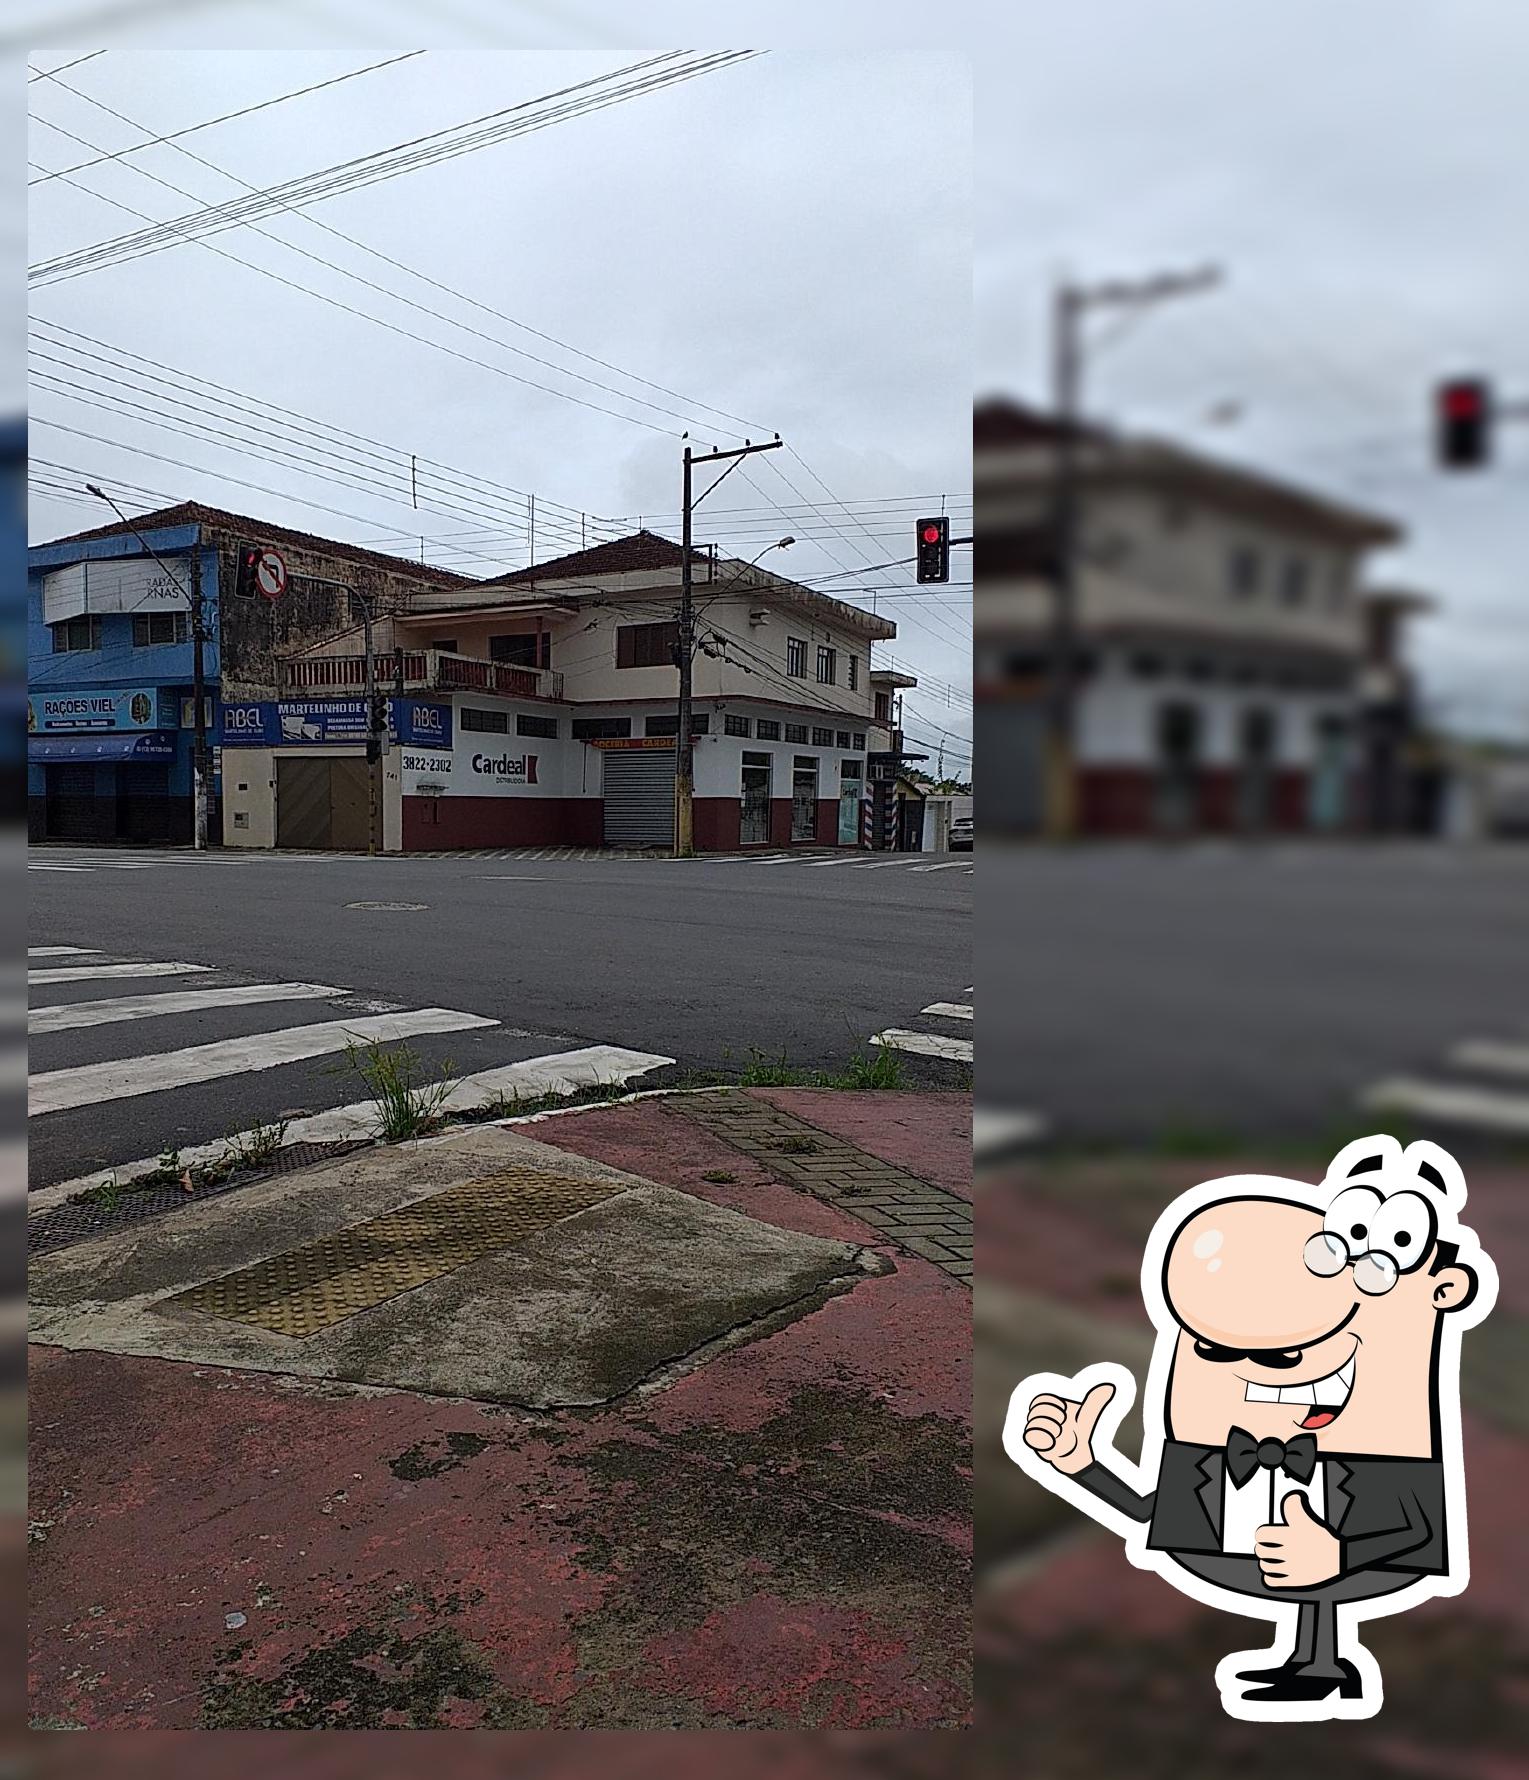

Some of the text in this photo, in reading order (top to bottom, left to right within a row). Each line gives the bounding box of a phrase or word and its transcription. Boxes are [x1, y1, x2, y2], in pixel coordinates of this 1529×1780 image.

[45, 697, 115, 717] RAÇÕES VIEL
[278, 703, 346, 715] MARTELINHO
[349, 703, 361, 712] DE
[413, 706, 442, 728] ABEL
[225, 708, 263, 728] ABEL
[472, 753, 526, 775] Cardeal
